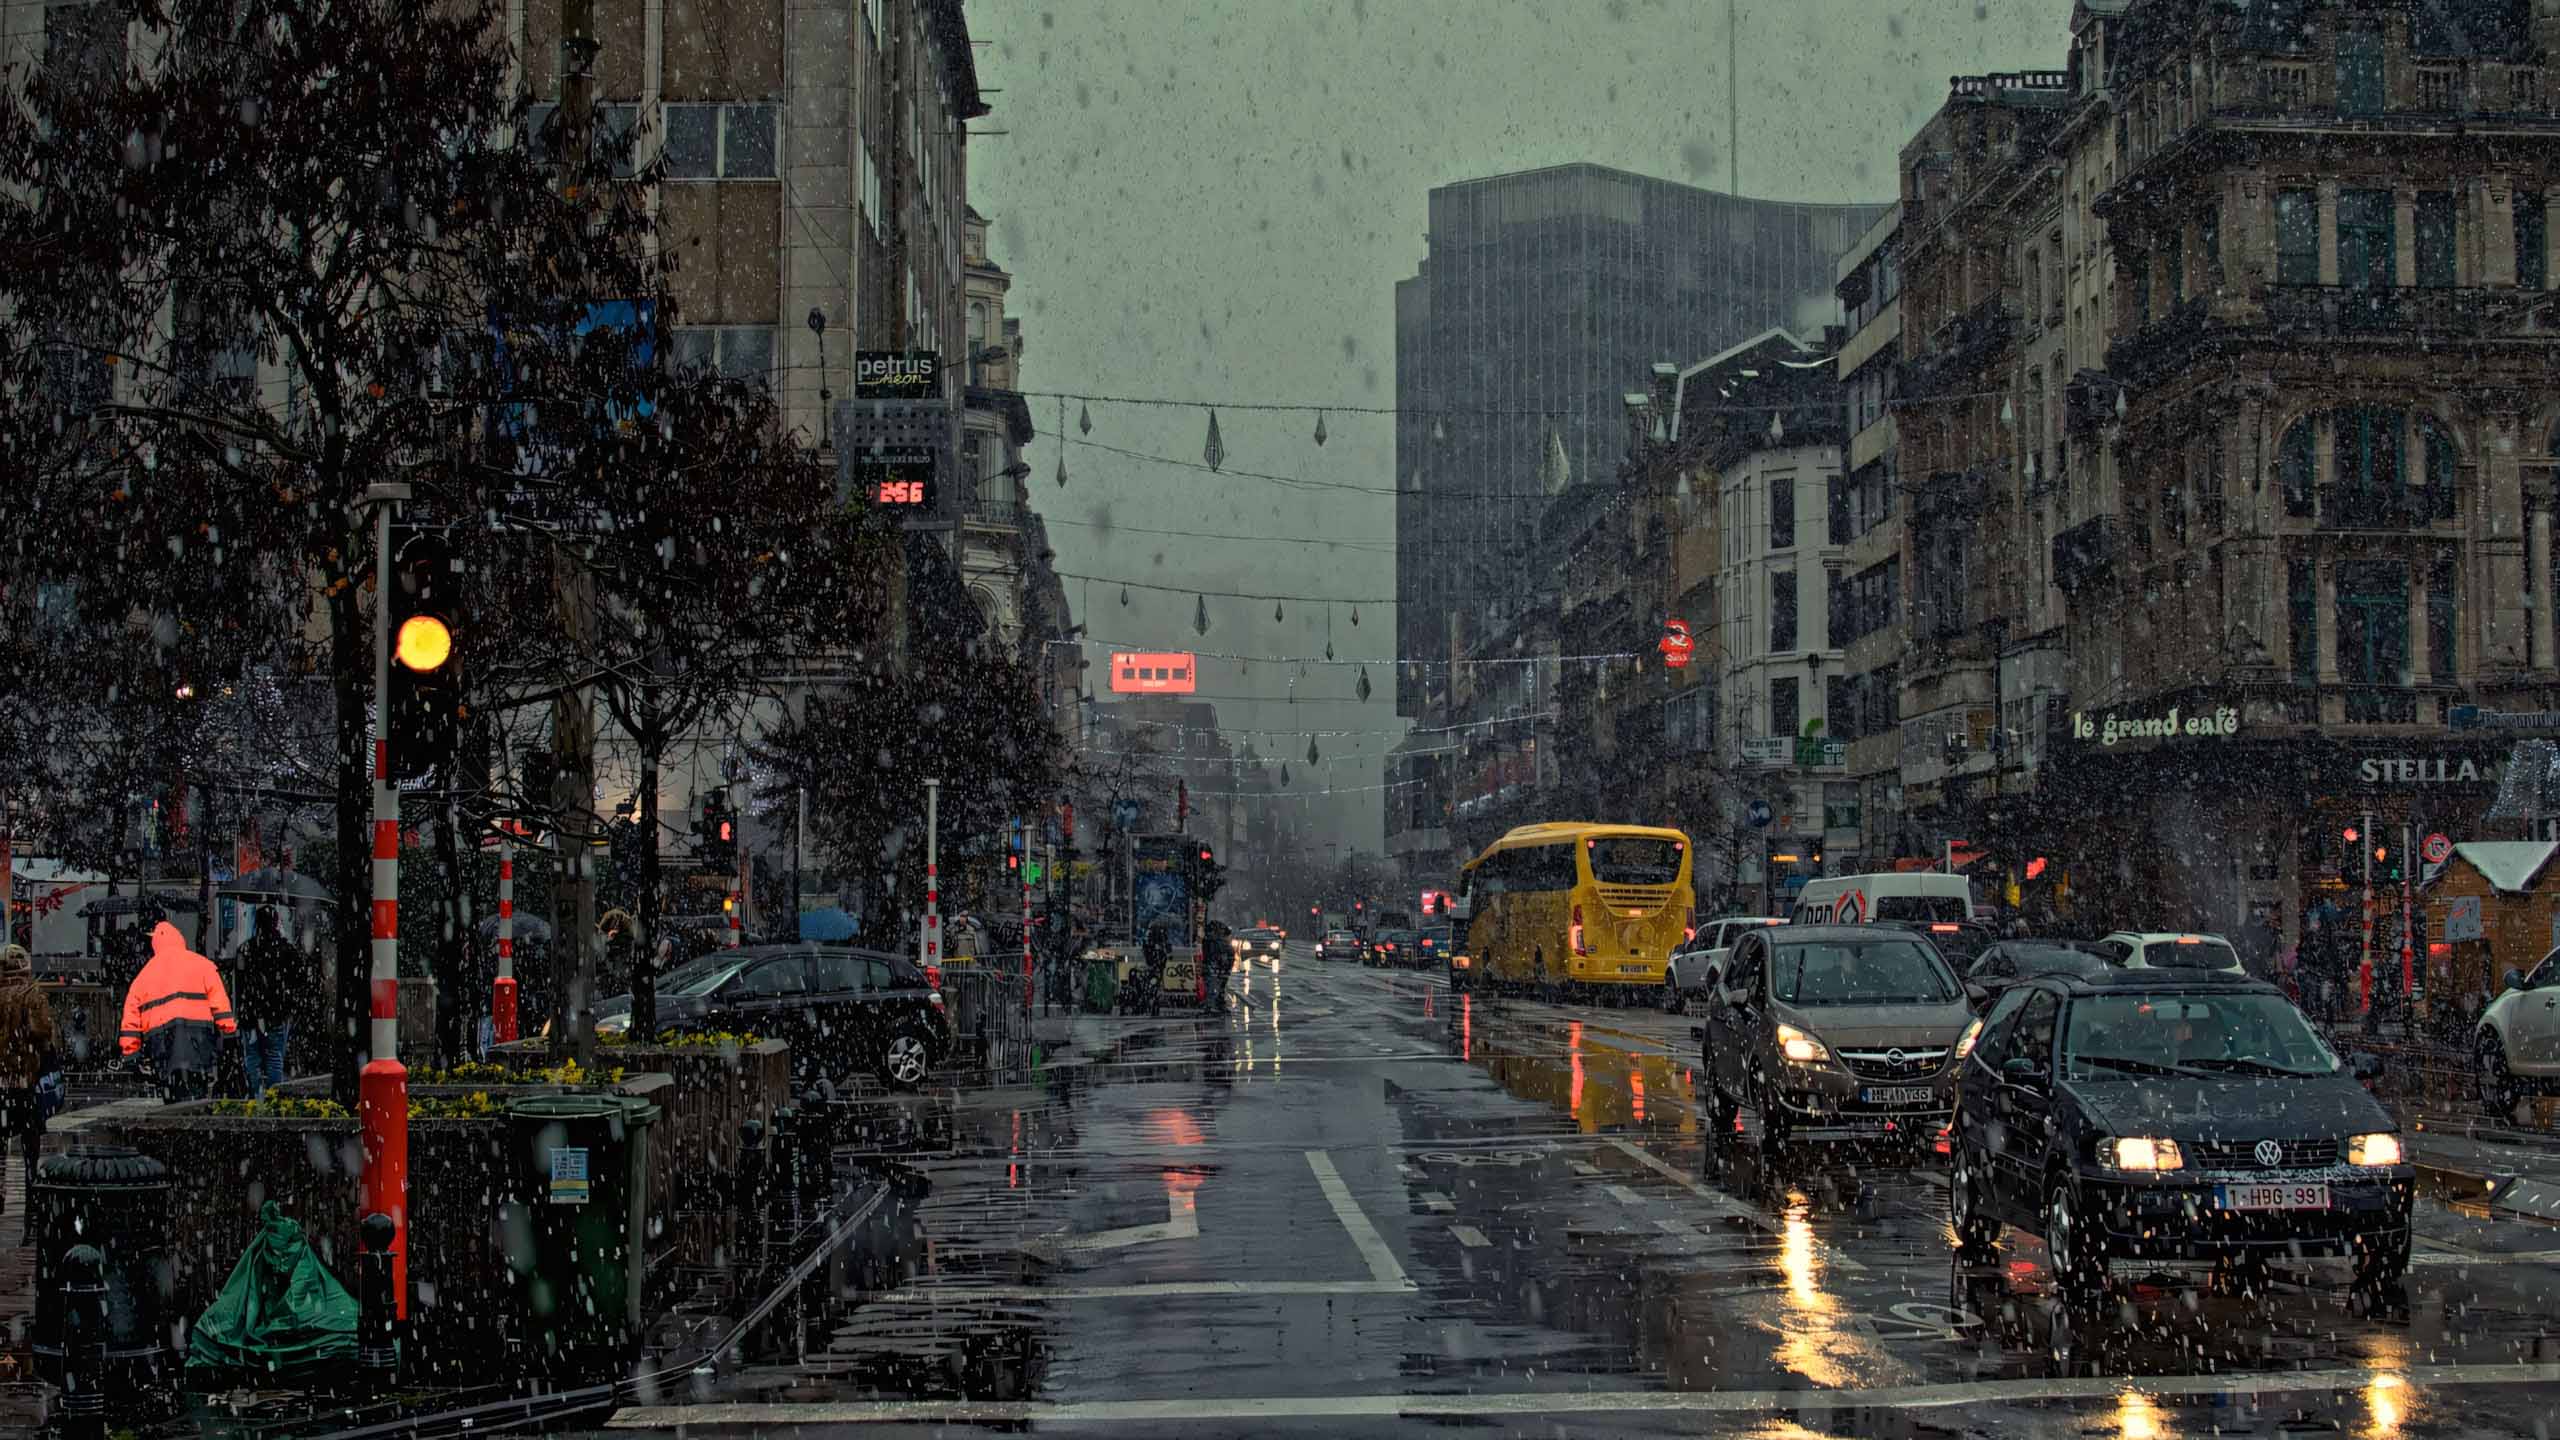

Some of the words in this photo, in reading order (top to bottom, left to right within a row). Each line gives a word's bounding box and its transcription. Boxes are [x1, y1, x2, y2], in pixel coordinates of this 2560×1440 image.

[857, 354, 933, 384] petrus
[2073, 711, 2095, 739] le
[2102, 707, 2178, 747] grand
[2184, 704, 2239, 736] café
[2360, 757, 2481, 784] STELLA
